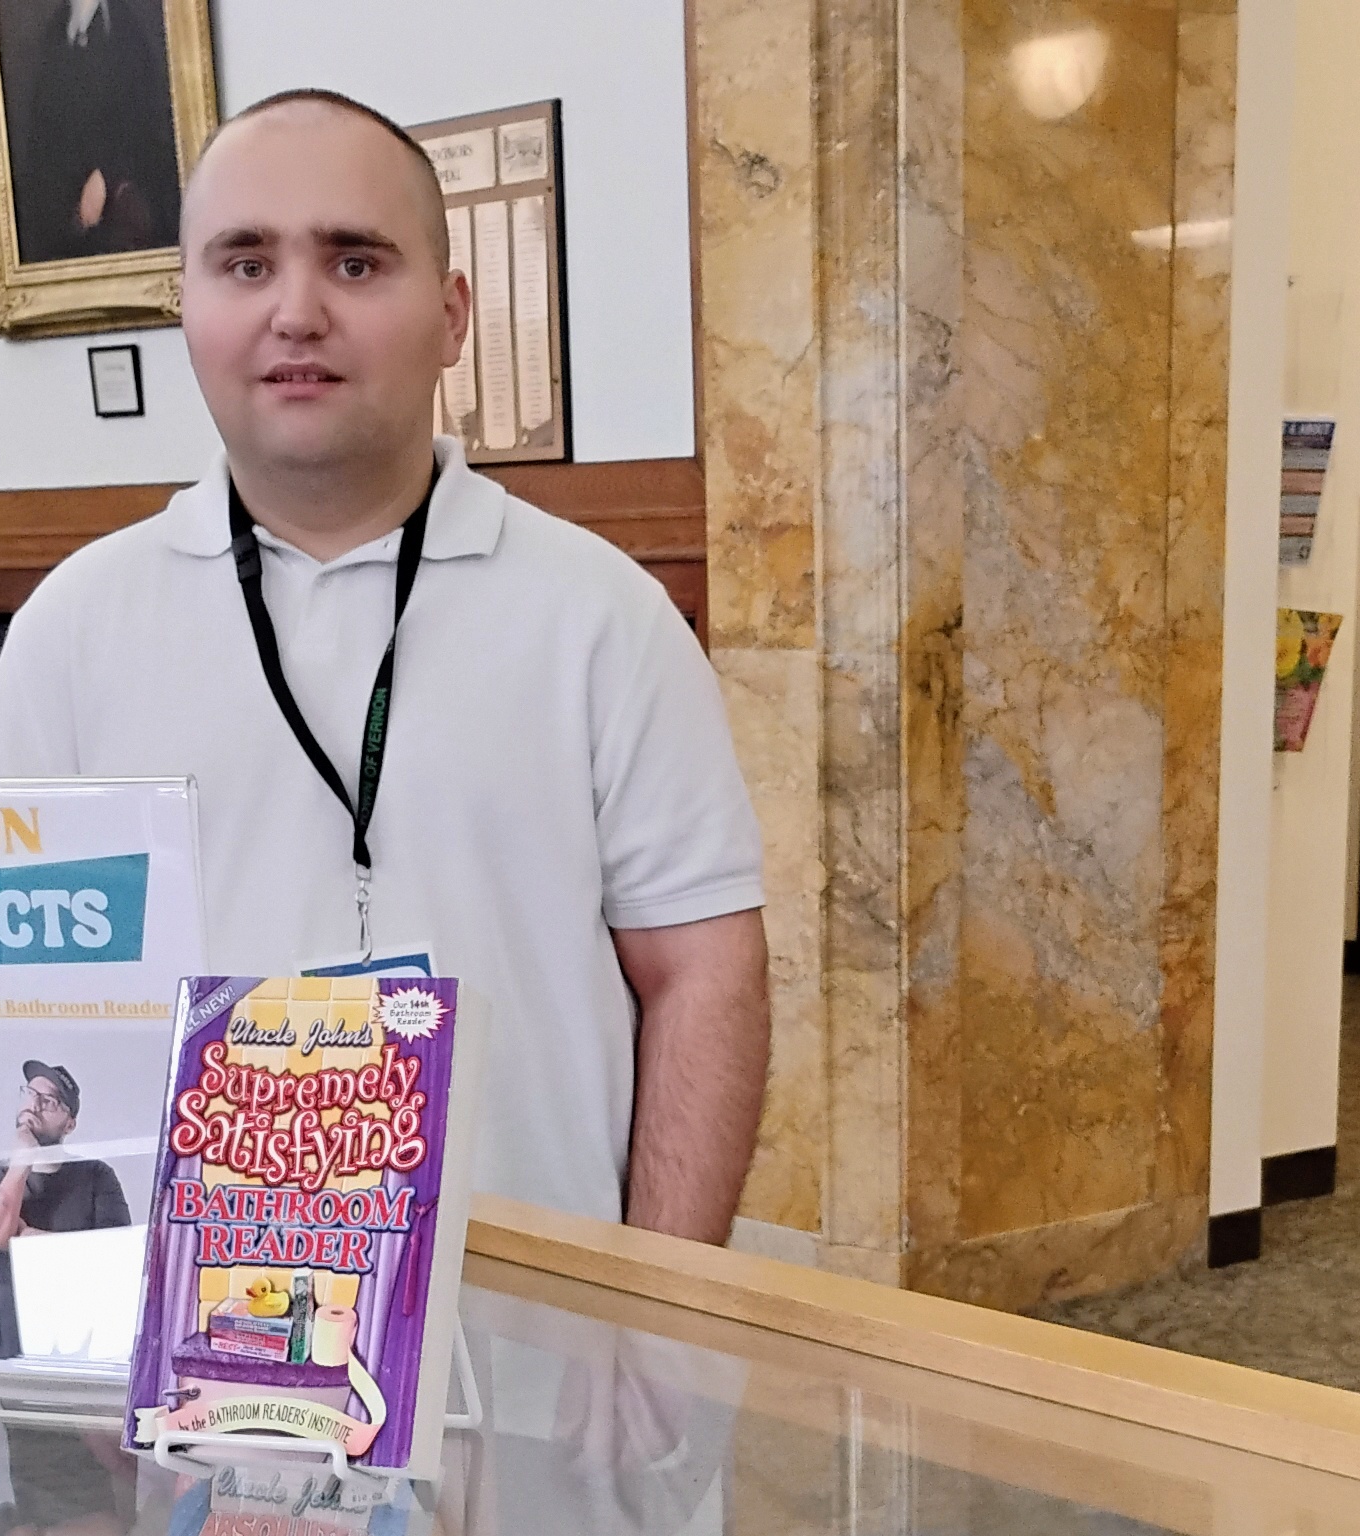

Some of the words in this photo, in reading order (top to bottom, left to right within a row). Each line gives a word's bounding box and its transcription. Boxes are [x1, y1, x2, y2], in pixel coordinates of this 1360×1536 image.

[367, 687, 387, 752] VERNON
[364, 755, 378, 778] OF
[5, 998, 100, 1017] Bathroom
[103, 998, 173, 1018] Reader
[198, 985, 237, 1021] NEW!
[389, 1007, 432, 1018] Bathroom
[393, 1001, 408, 1010] Our
[396, 1017, 427, 1027] Reader
[230, 1016, 297, 1047] Uncle
[301, 1018, 374, 1056] John's
[200, 1042, 423, 1117] Supremely
[169, 1091, 427, 1194] Satisfying
[170, 1179, 415, 1231] BATHROOM
[196, 1223, 375, 1272] READER
[191, 1416, 206, 1430] the
[207, 1402, 261, 1427] BATHROOM
[262, 1400, 309, 1422] READERS'
[307, 1413, 354, 1444] INSTITUTE
[216, 1465, 287, 1504] Uncle
